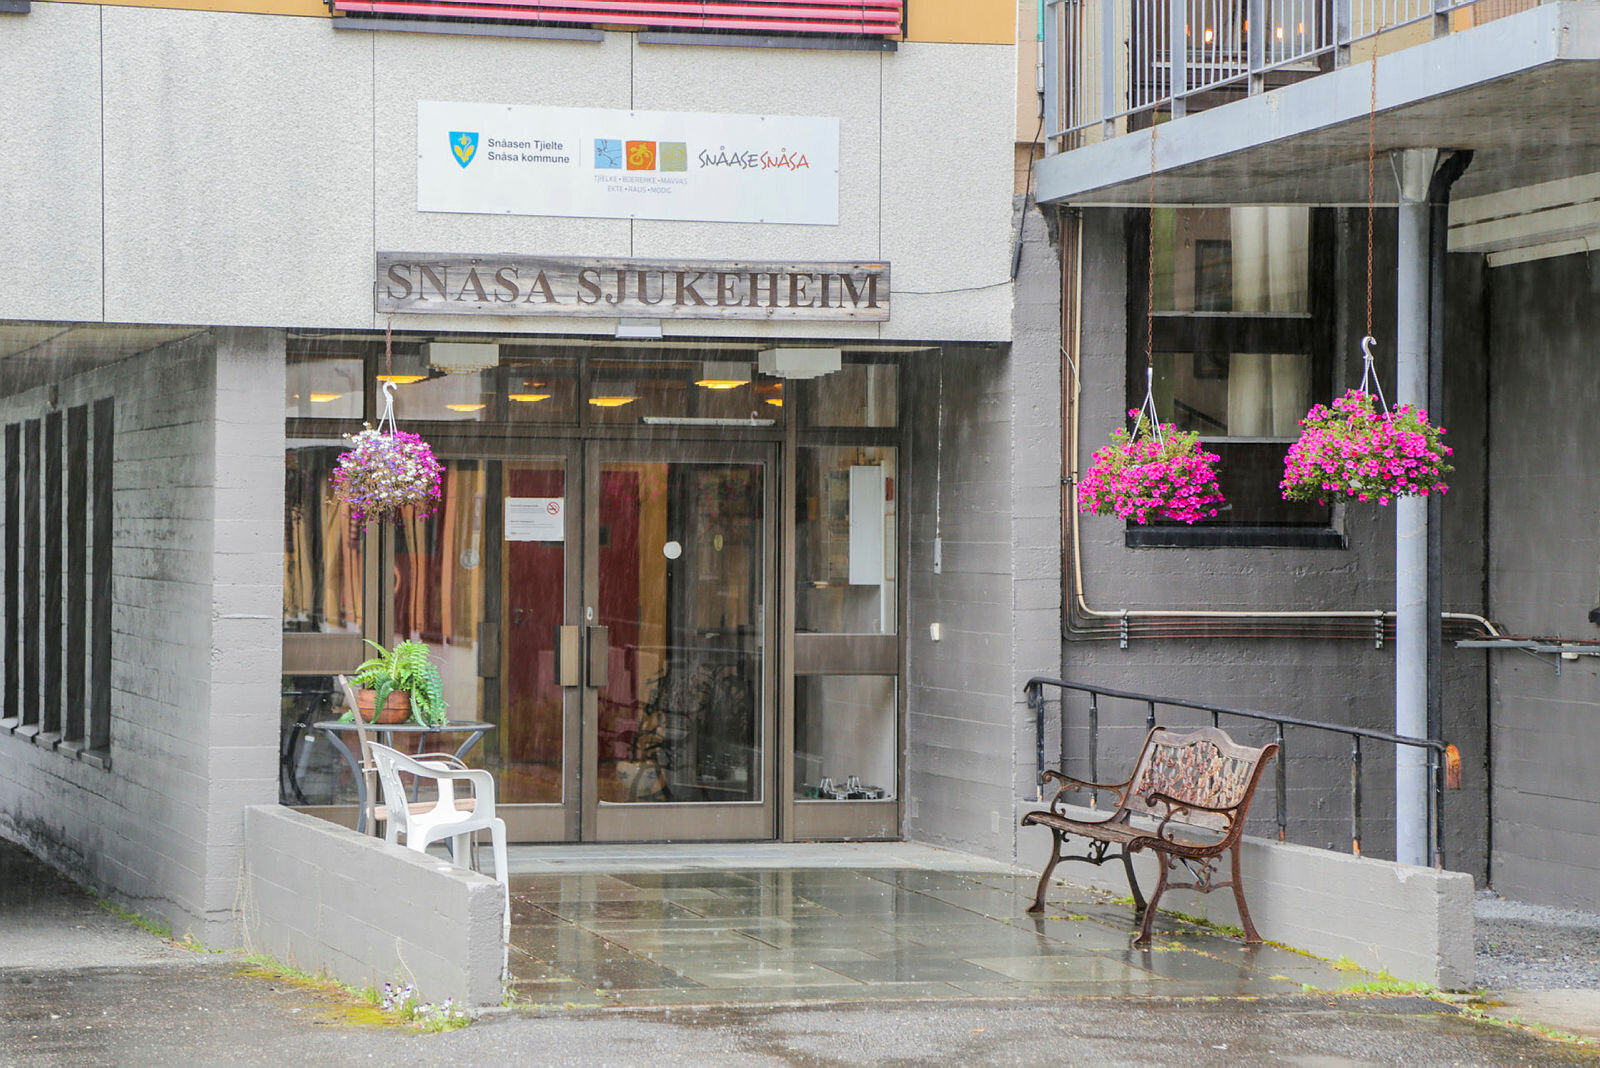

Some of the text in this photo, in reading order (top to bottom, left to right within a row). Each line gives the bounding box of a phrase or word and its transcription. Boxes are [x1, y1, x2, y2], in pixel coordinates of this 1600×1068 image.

[487, 138, 564, 152] Snåasen Tjielte
[487, 151, 570, 164] Snåsa kommune
[698, 145, 810, 171] SNÅASE SNÅSA
[387, 258, 882, 310] SNÅSA SJUKEHEIM
